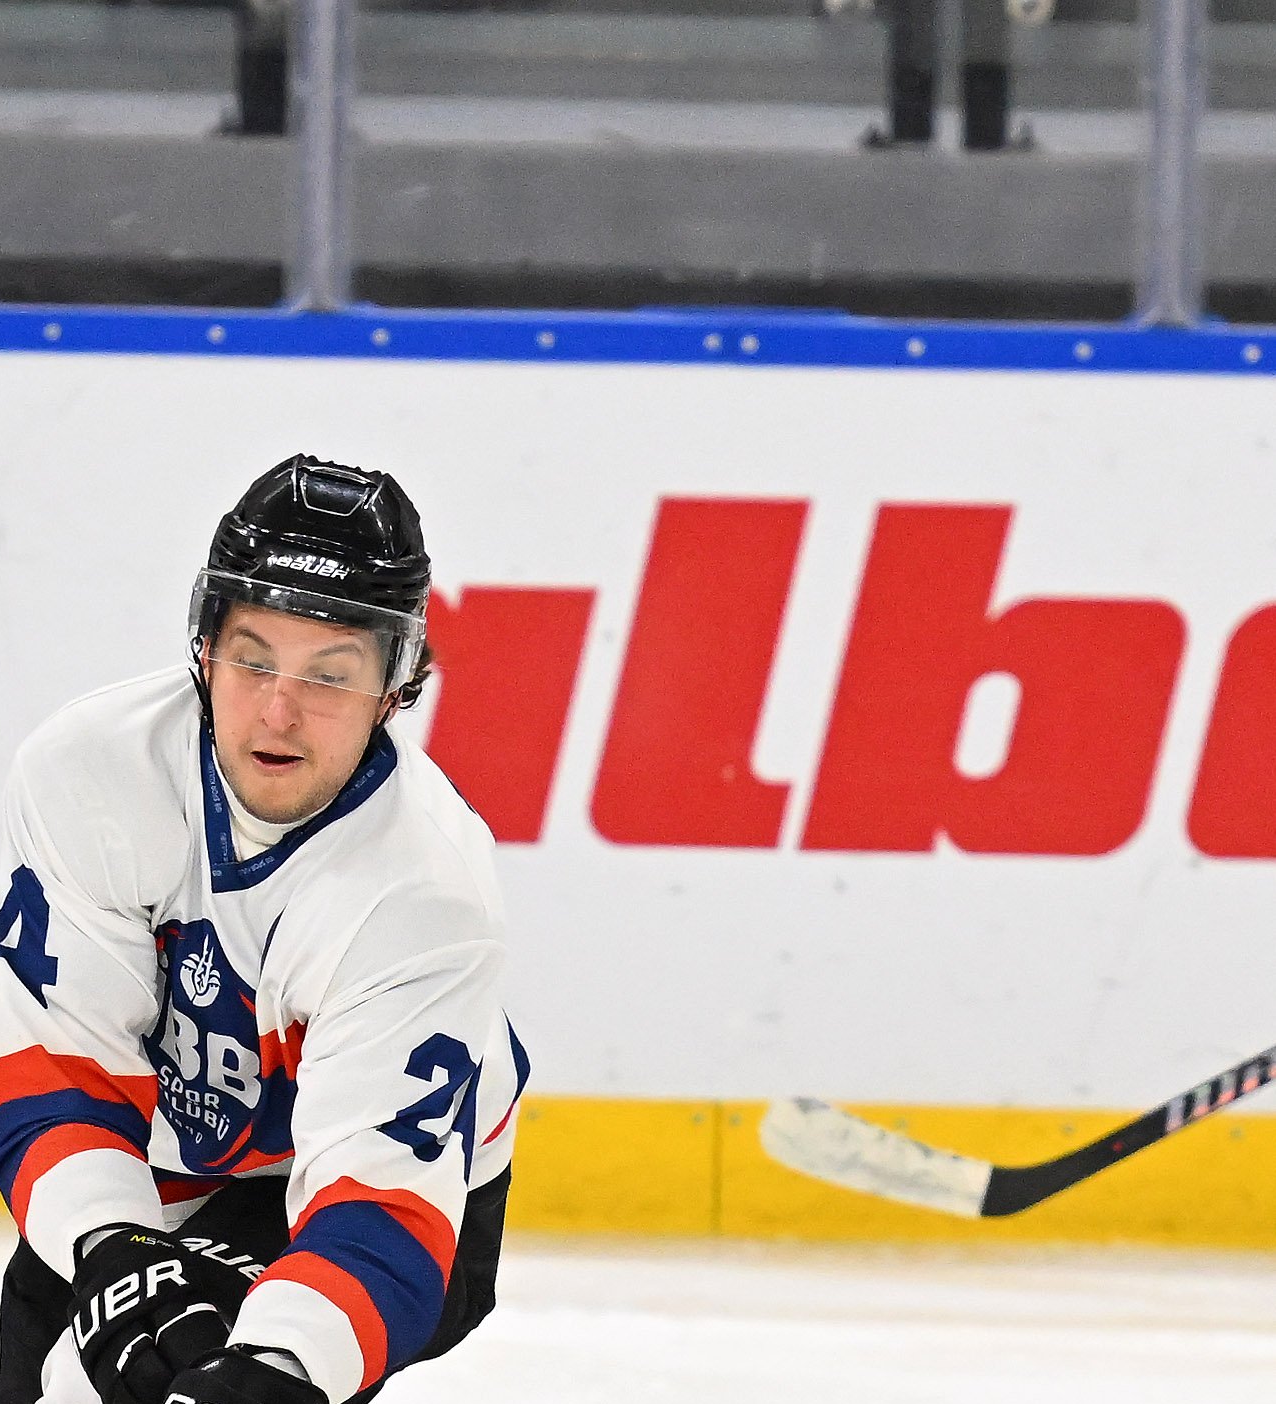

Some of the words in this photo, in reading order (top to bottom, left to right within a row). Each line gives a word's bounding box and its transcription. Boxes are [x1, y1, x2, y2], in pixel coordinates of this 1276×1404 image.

[158, 1064, 221, 1110] SPOR
[160, 1085, 231, 1142] LÜBÜ
[73, 1258, 190, 1351] UER
